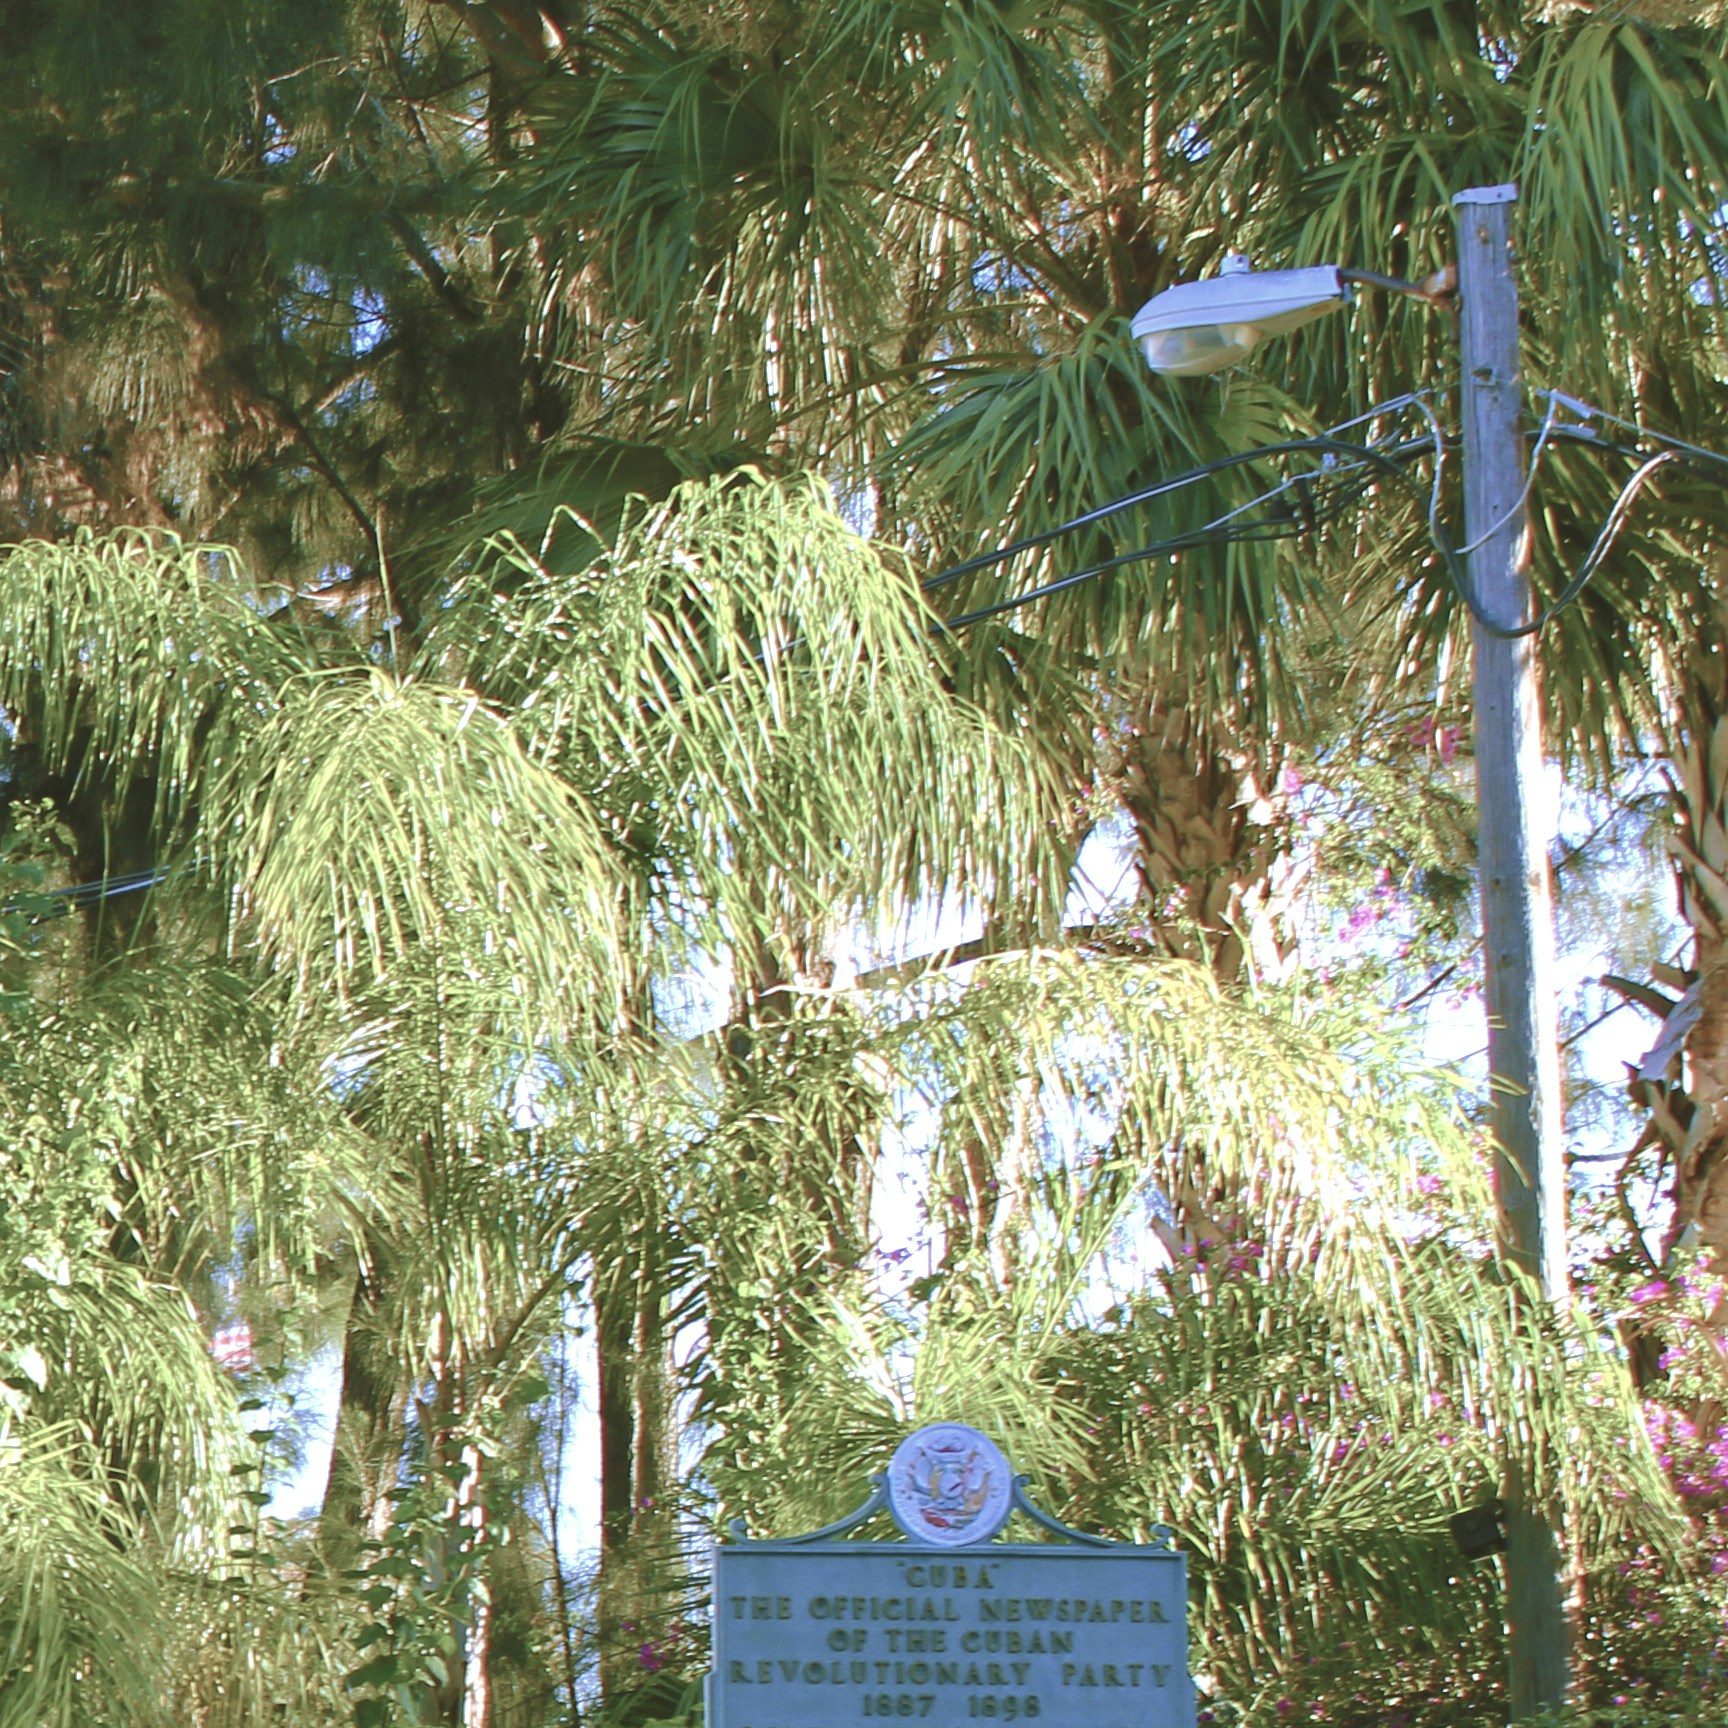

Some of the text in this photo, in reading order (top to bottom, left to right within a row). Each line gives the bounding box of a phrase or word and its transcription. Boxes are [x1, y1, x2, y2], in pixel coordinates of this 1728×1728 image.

[730, 1595, 1171, 1625] THE OFFICIAL NEWSPAPER
[827, 1628, 1075, 1655] OF THE CUBAN
[729, 1660, 1172, 1688] REVOLUTIONARY PARTY
